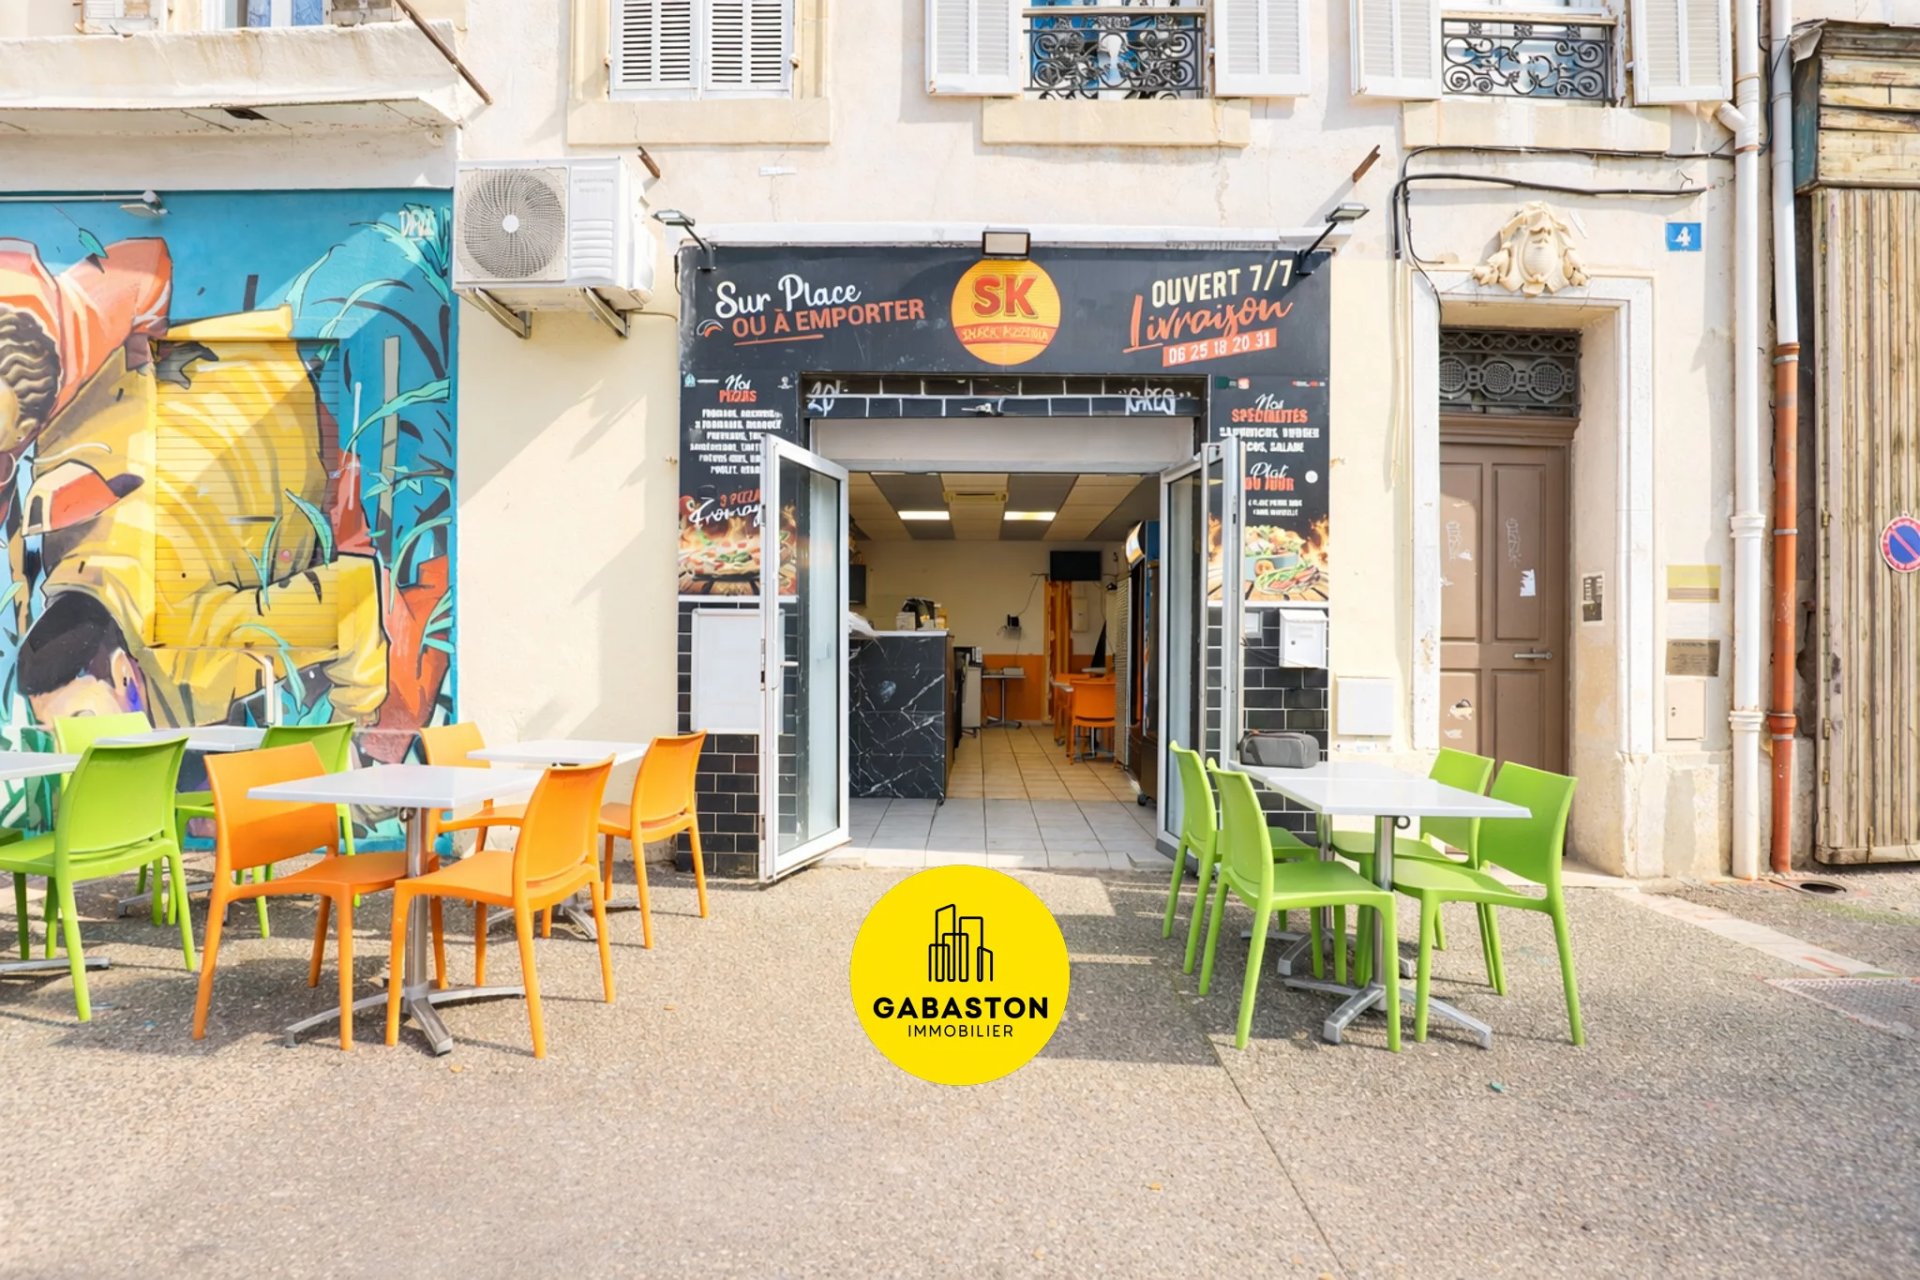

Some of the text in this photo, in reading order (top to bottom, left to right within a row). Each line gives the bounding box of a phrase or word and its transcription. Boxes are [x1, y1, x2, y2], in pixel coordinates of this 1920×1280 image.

[1673, 226, 1692, 247] 4
[714, 273, 861, 318] Sur Place
[972, 274, 1039, 318] SK
[1152, 259, 1294, 308] OUVERT 7/7
[732, 298, 926, 337] OU À EMPORTER
[1123, 294, 1294, 353] Livraison
[1169, 331, 1271, 365] 06 25 18 20 31
[1250, 461, 1289, 479] Plat
